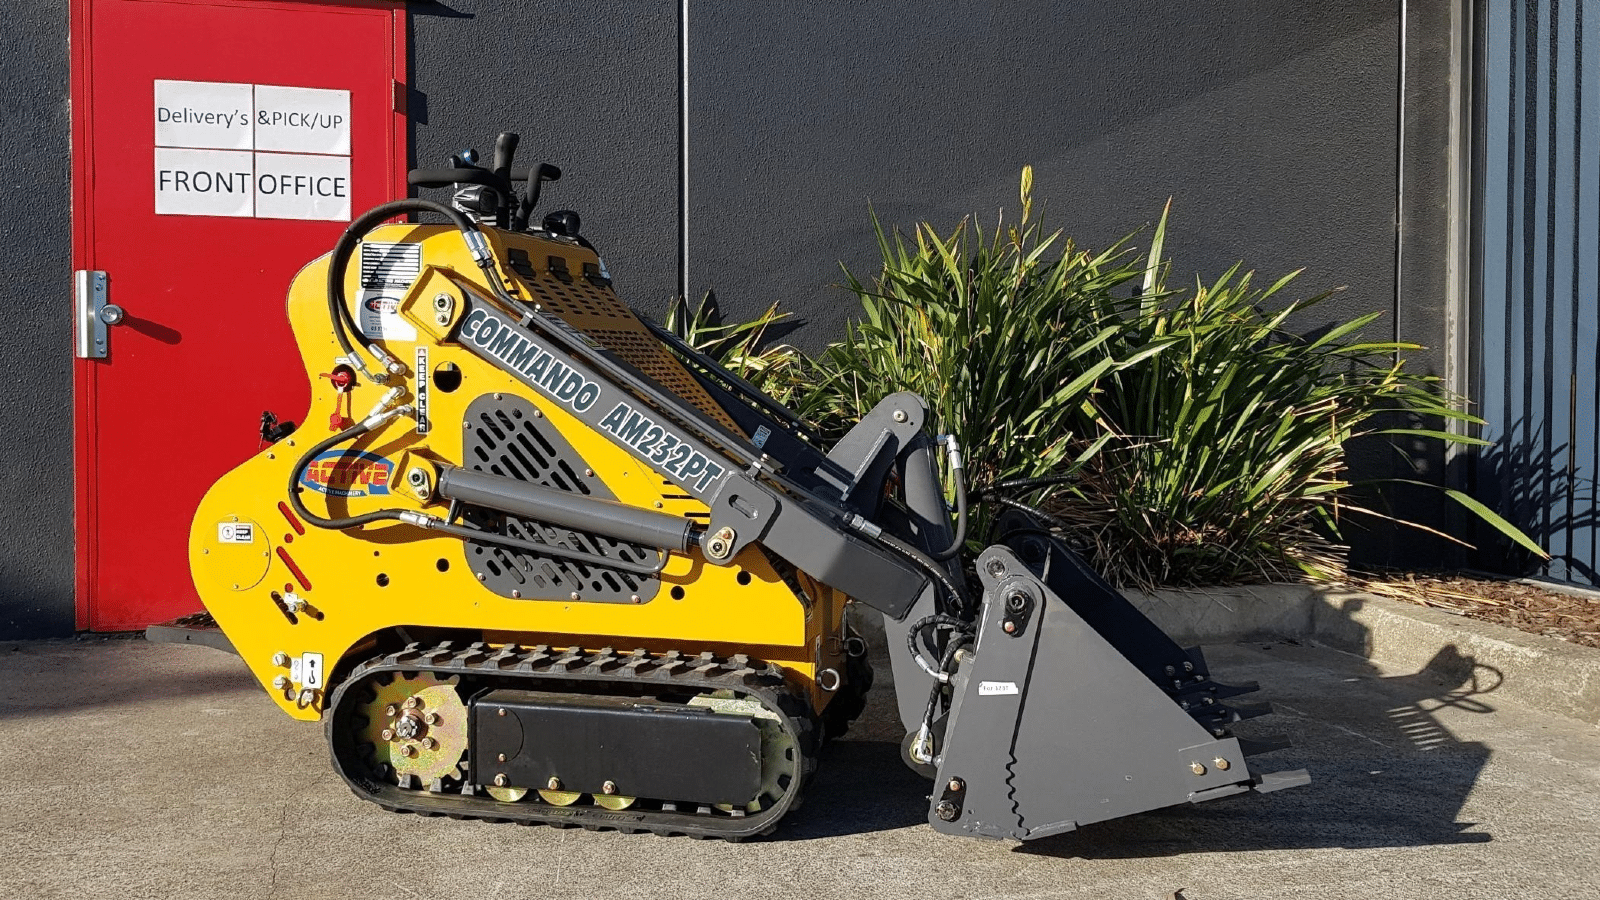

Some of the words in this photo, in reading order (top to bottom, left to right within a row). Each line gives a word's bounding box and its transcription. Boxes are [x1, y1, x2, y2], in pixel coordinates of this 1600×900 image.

[257, 110, 343, 130] &PICK/UP
[159, 170, 251, 194] FRONT
[258, 174, 346, 198] OFFICE
[418, 356, 426, 388] KEEP
[418, 392, 426, 431] CLEAR
[460, 308, 601, 413] COMMANDO
[598, 402, 725, 493] AM232PT
[304, 460, 389, 486] ACTIVE
